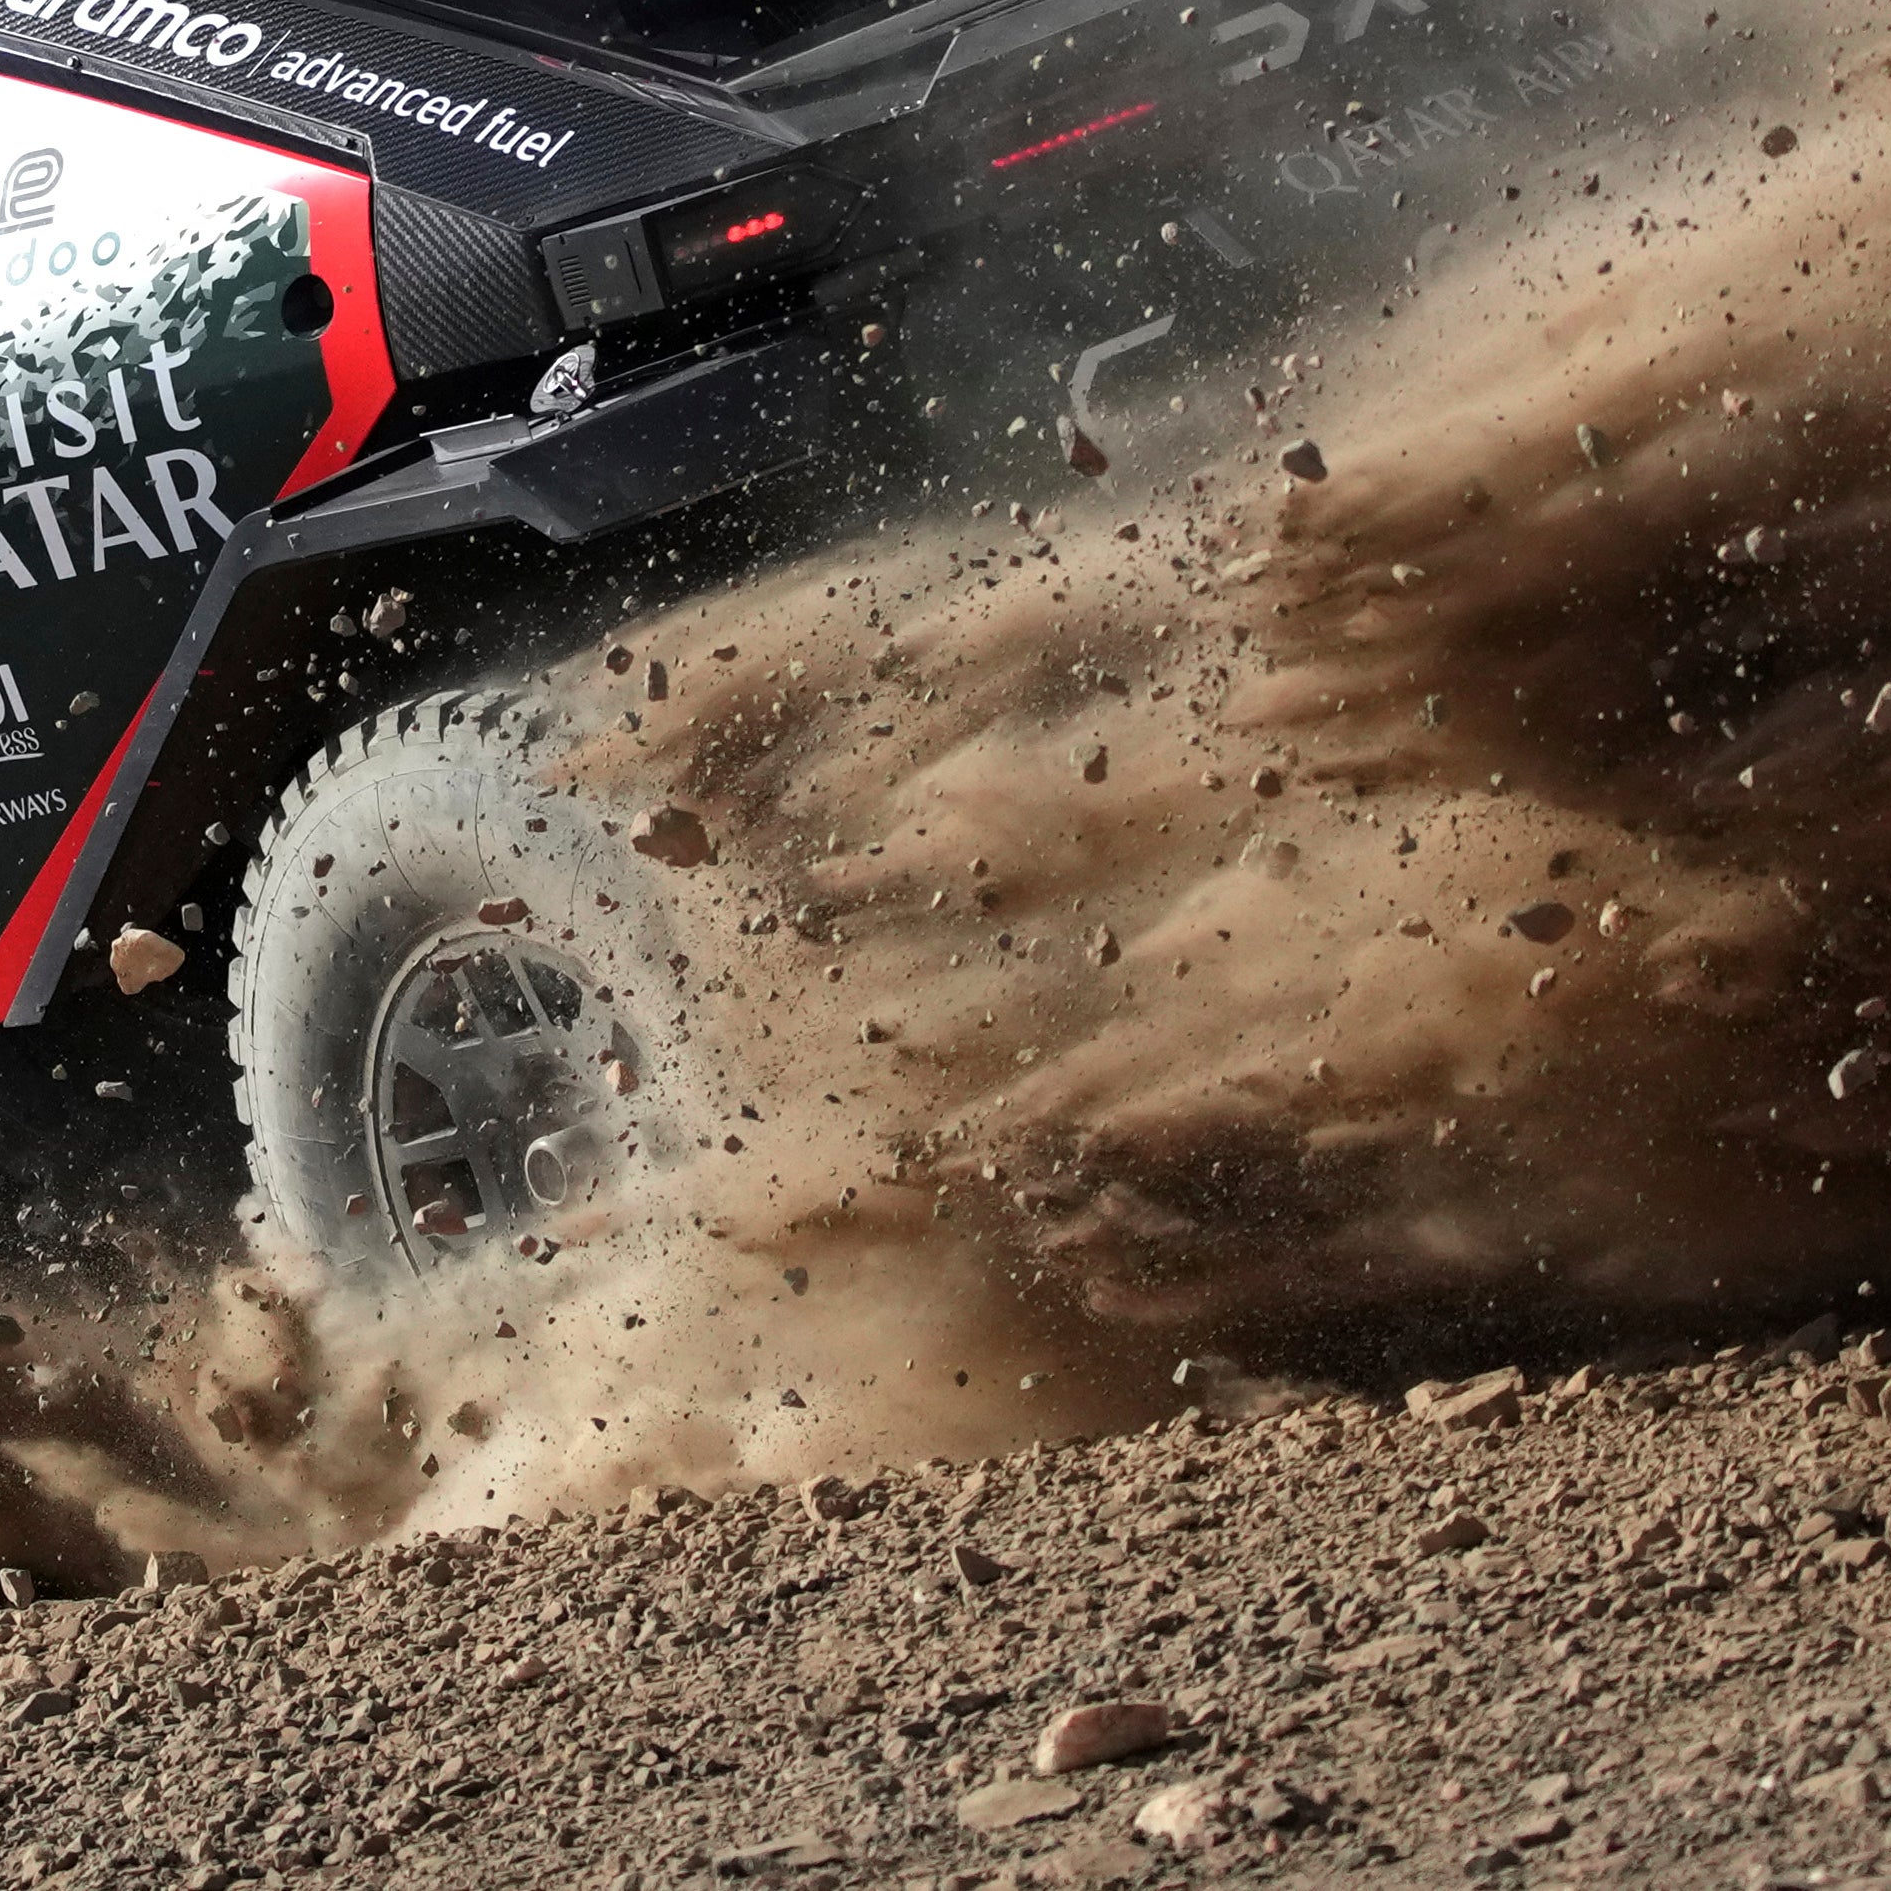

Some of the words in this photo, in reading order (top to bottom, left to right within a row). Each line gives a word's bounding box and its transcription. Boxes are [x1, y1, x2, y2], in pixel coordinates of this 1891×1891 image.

[271, 46, 485, 137] advanced
[474, 102, 575, 168] fuel
[1278, 88, 1499, 198] QATAR
